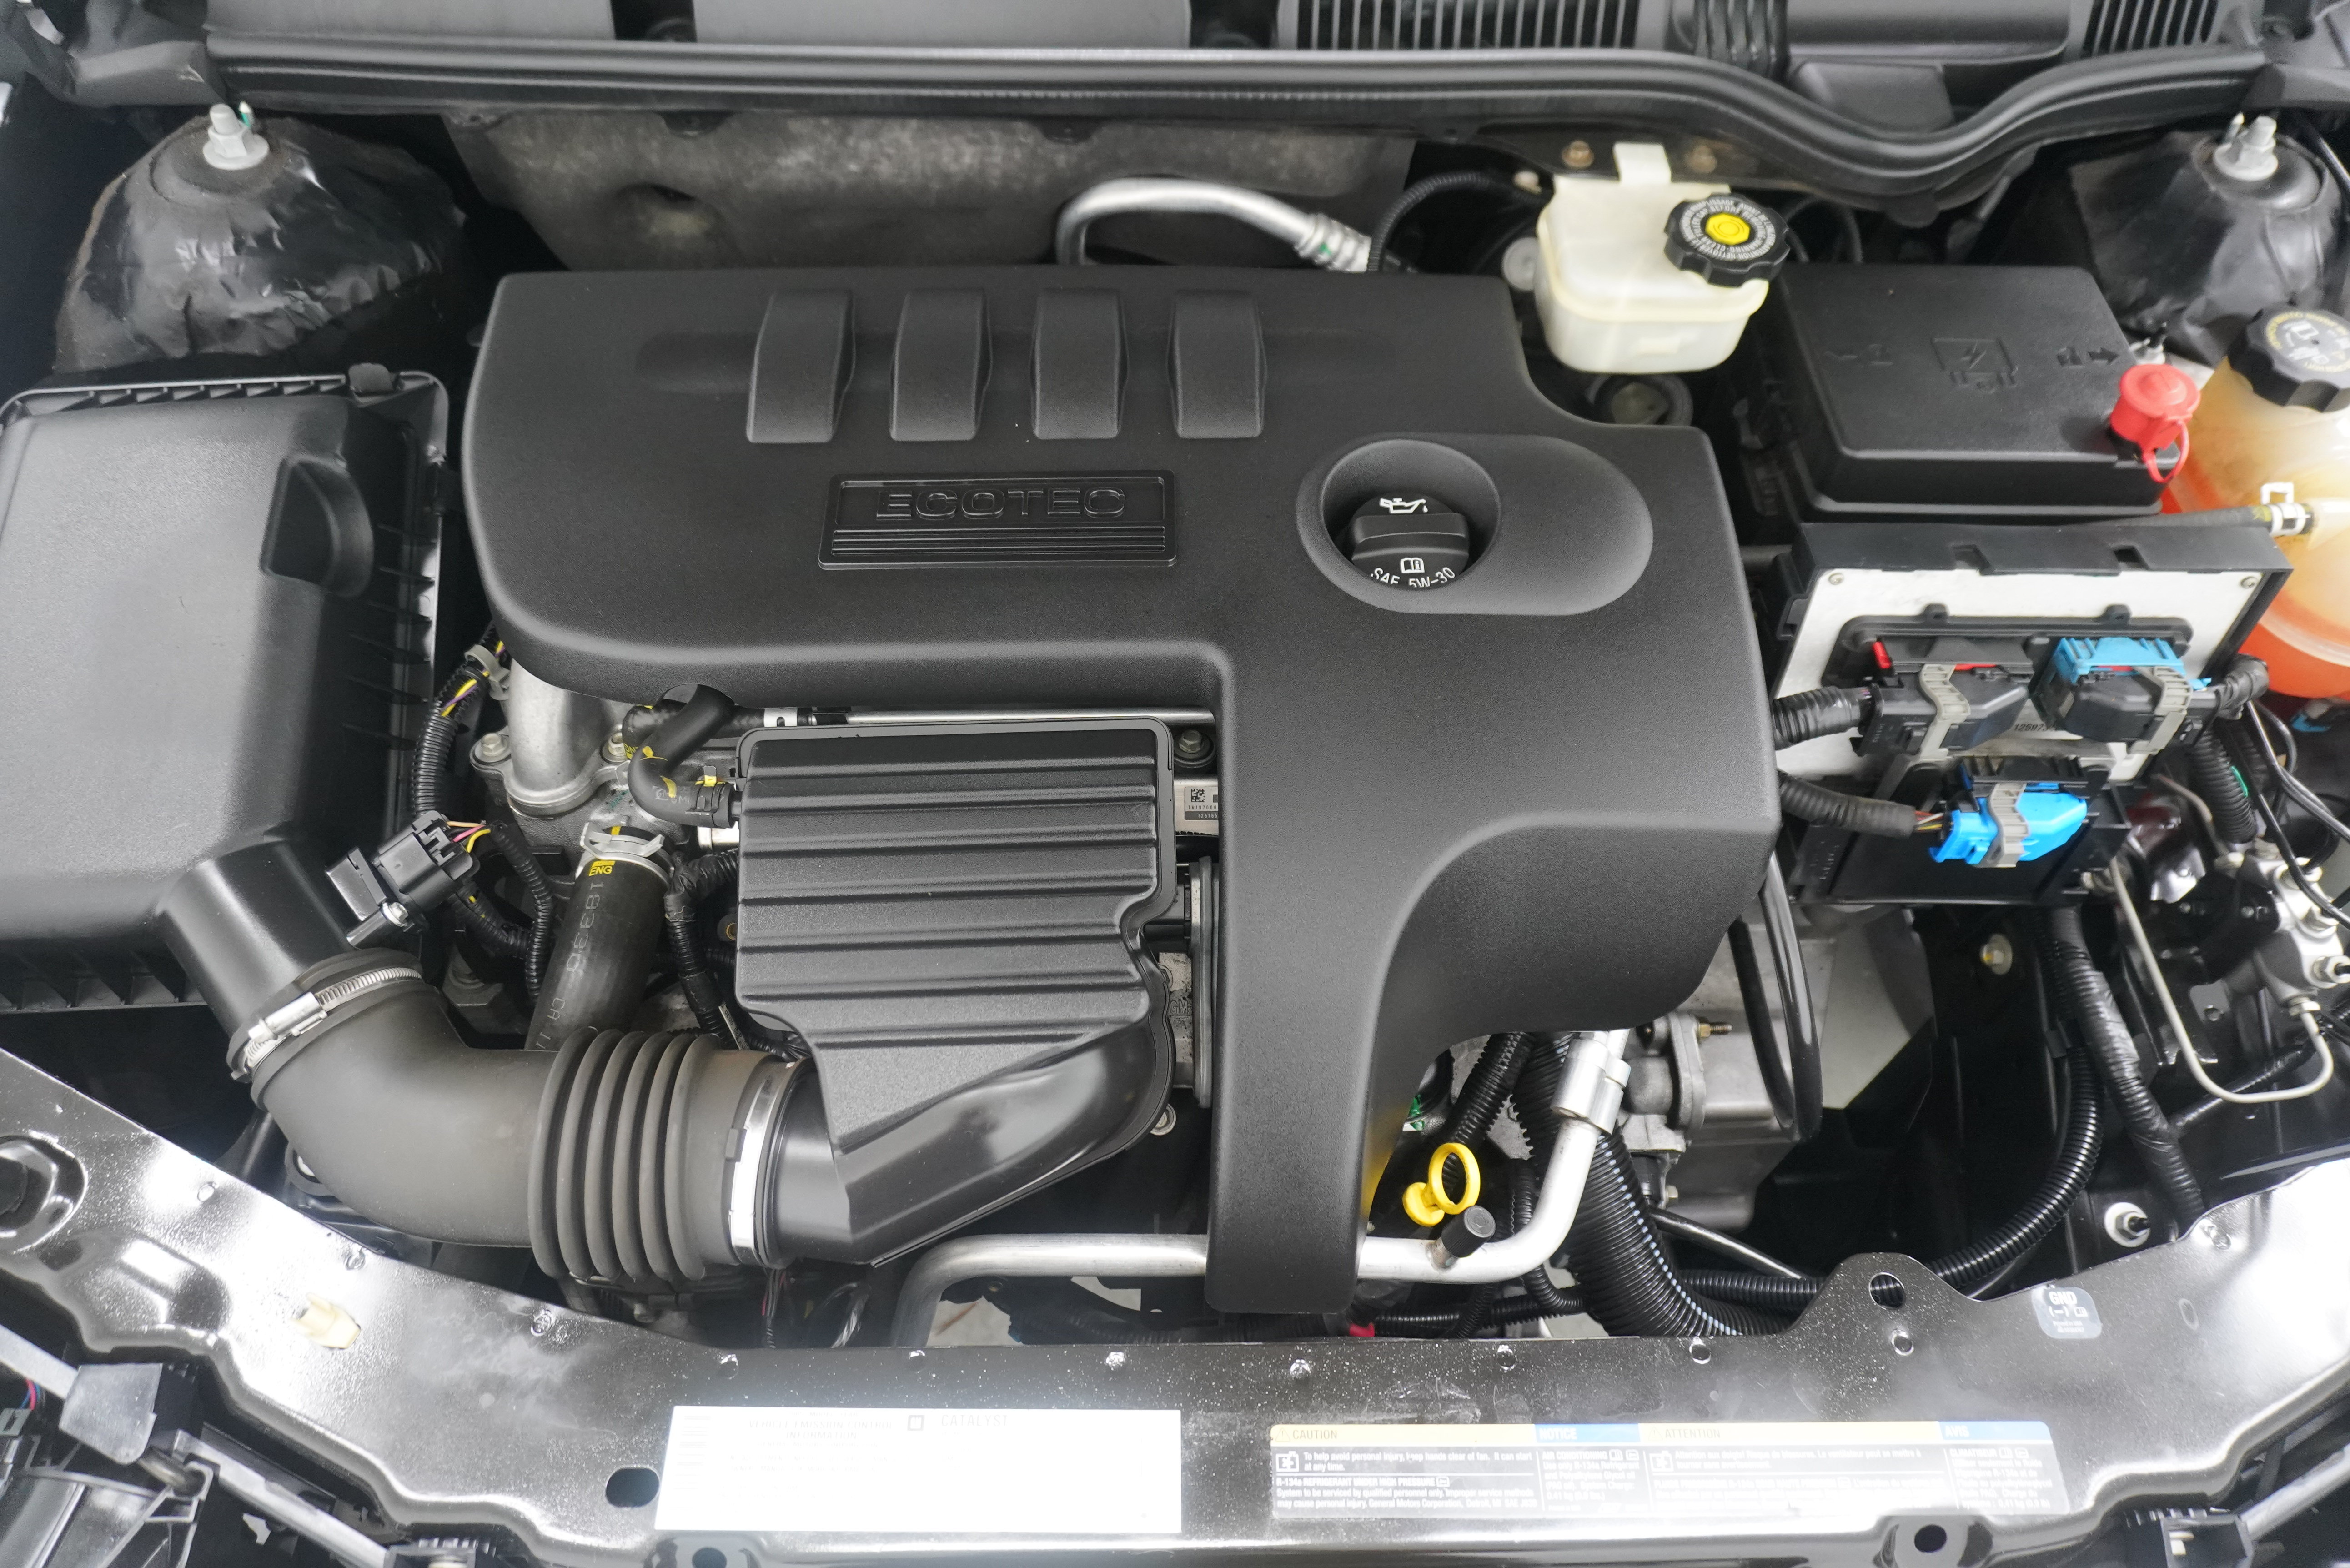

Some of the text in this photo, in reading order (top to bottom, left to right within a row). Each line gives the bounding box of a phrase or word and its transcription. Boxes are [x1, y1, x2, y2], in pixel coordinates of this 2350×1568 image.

[876, 487, 1126, 521] ECOTEC
[1371, 567, 1455, 587] SAE 5W-30
[589, 865, 613, 876] ENG
[1170, 1000, 1188, 1014] GM
[2049, 1291, 2077, 1305] GND
[941, 1415, 1008, 1426] CATALYST
[1293, 1430, 1337, 1440] CAUTION
[1539, 1428, 1577, 1440] NOTICE
[1665, 1429, 1721, 1439] ATTENTION
[1945, 1426, 1969, 1437] AVIS
[1304, 1452, 1312, 1460] To
[1314, 1452, 1329, 1462] help
[1331, 1452, 1350, 1460] avoid
[1351, 1452, 1381, 1462] personal
[1383, 1452, 1405, 1462] injury,
[1406, 1452, 1423, 1462] keep
[1425, 1452, 1446, 1461] hands
[1448, 1452, 1466, 1461] clear
[1468, 1452, 1475, 1461] of
[1476, 1452, 1490, 1461] fan.
[1494, 1452, 1500, 1461] It
[1516, 1452, 1532, 1461] start
[1542, 1451, 1608, 1460] AIR CONDITIONING
[1313, 1464, 1326, 1473] any
[1327, 1462, 1345, 1471] time.
[1543, 1461, 1557, 1470] Use
[1276, 1478, 1436, 1486] R-134a REFRIGERANT UNDER HIGH PRESSURE
[1276, 1488, 1302, 1498] System
[1312, 1488, 1321, 1497] be
[1353, 1488, 1362, 1498] by
[1316, 1499, 1345, 1509] personal
[1368, 1499, 1395, 1508] General
